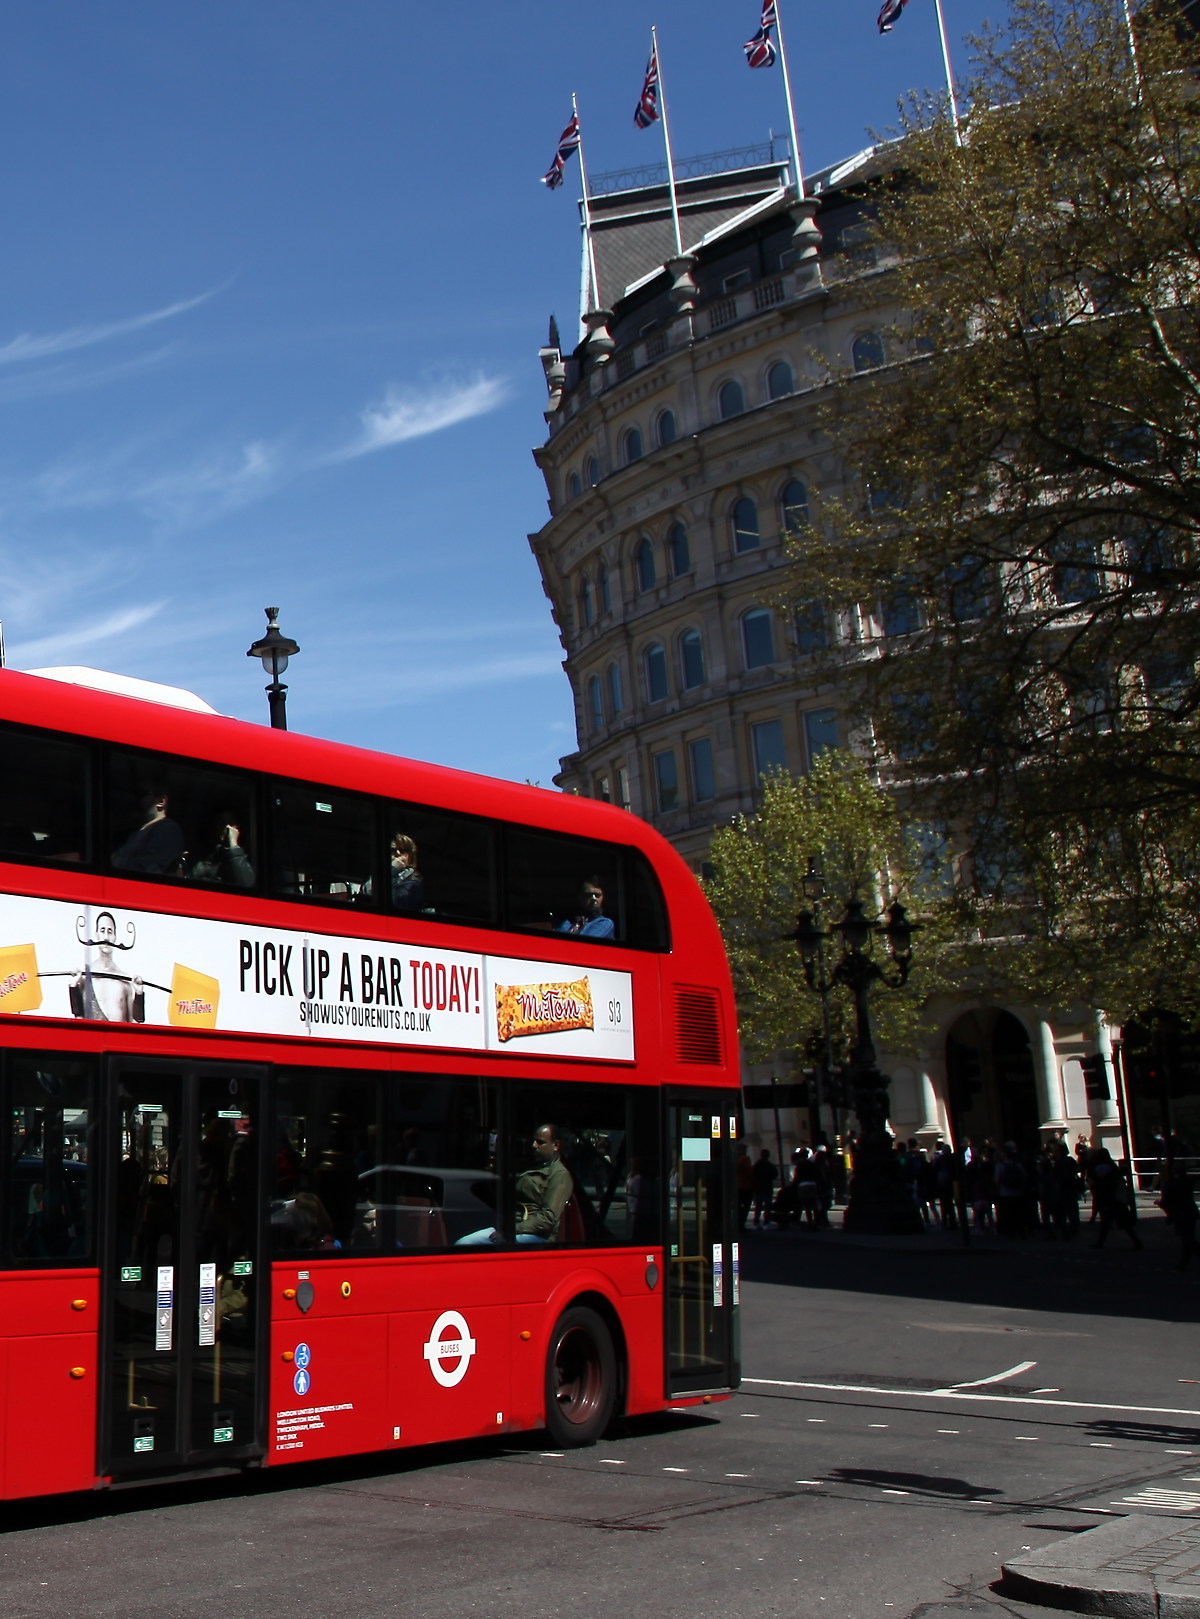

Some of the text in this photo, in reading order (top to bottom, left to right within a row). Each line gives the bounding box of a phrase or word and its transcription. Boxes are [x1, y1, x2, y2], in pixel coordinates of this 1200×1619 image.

[239, 939, 481, 1015] PICK UP A BAR TODAY!
[299, 1001, 432, 1033] SHOWUSYOURENUTS.CO.UK
[440, 1343, 460, 1355] BUSES
